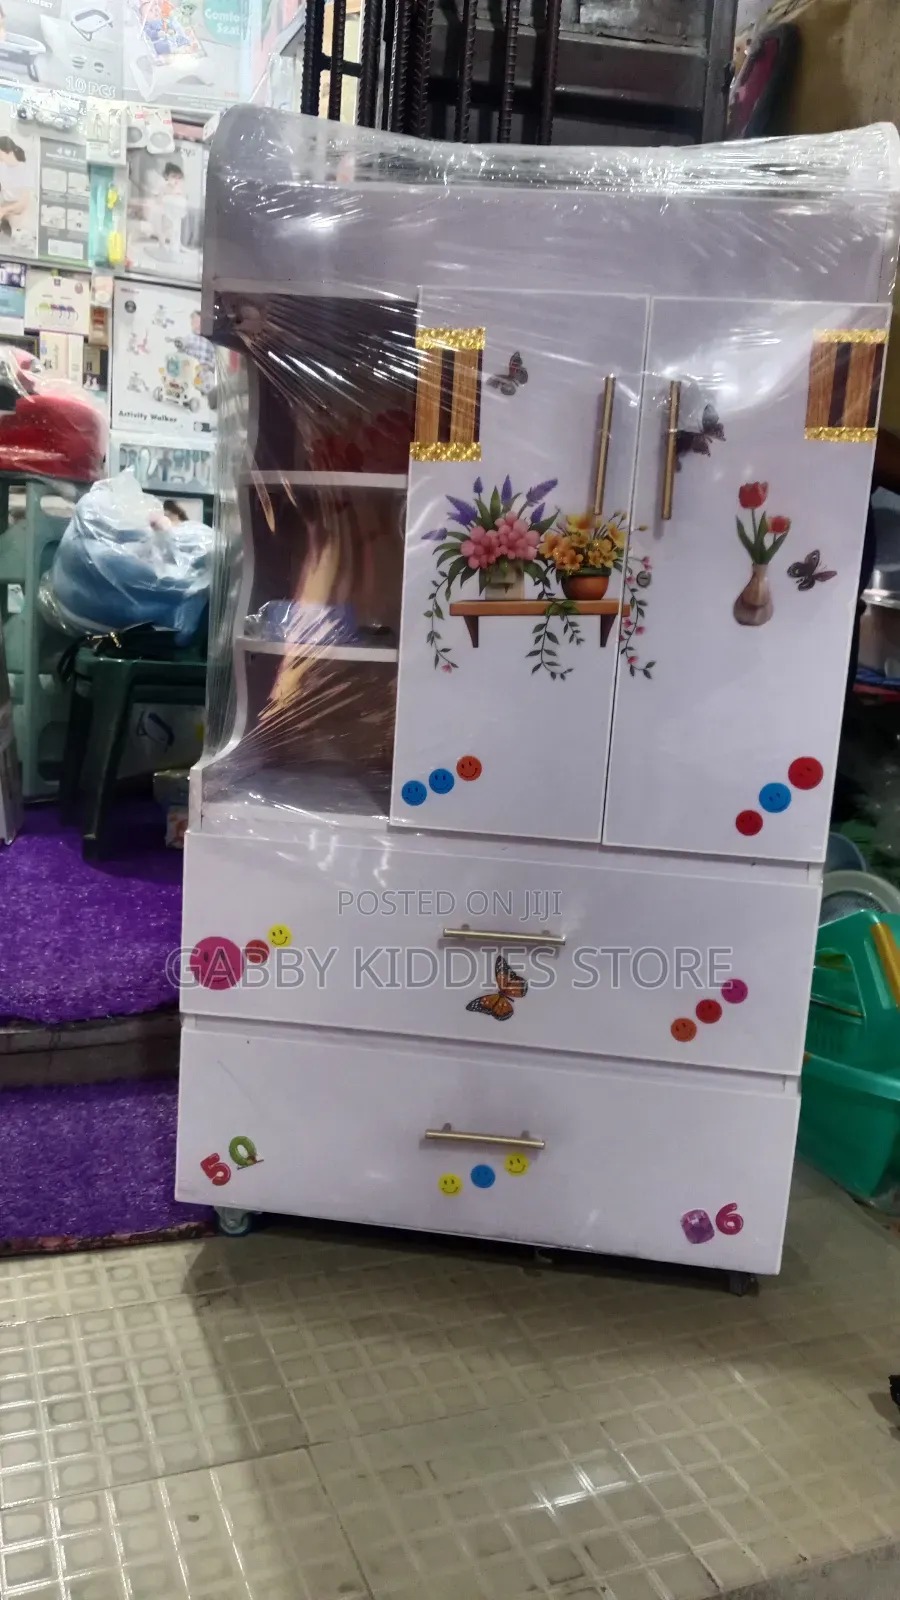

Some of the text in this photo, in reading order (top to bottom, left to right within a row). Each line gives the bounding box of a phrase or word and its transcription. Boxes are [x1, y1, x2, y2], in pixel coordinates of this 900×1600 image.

[65, 75, 86, 93] 10
[118, 410, 148, 421] Activity
[150, 414, 178, 423] Walker
[715, 1202, 744, 1235] 6
